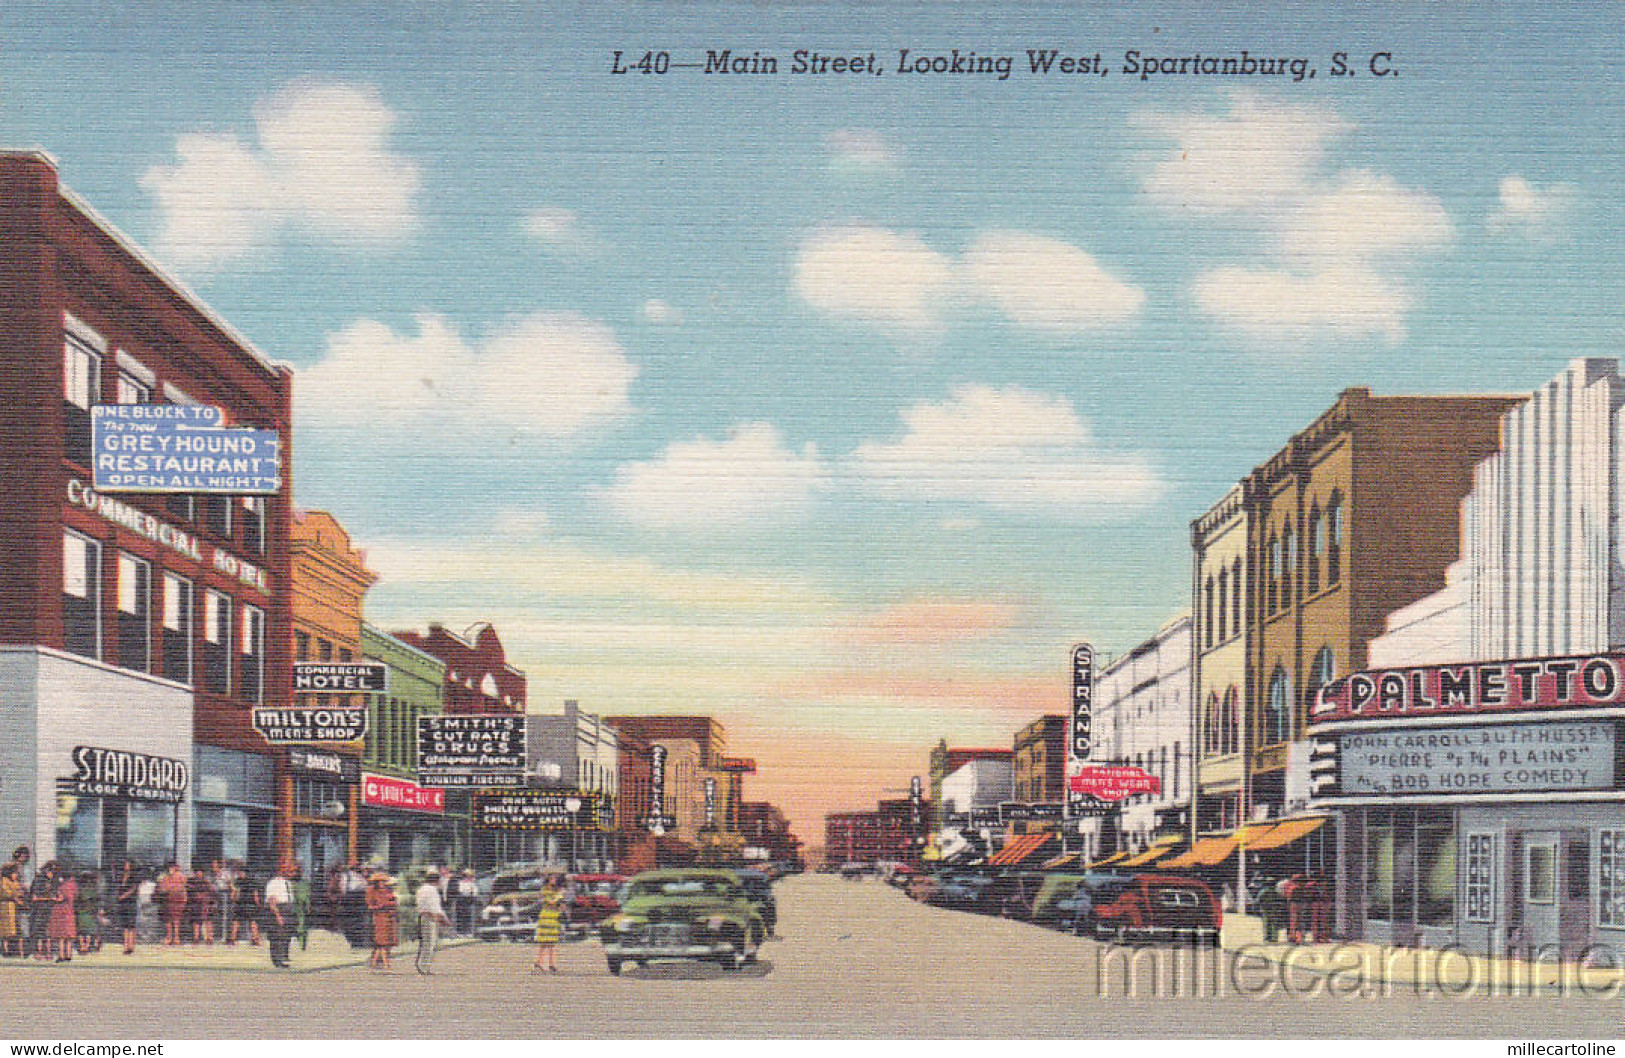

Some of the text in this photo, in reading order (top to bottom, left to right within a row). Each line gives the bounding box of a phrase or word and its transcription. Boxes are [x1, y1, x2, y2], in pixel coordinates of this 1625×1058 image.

[94, 405, 215, 420] ONE BLOCK TO
[103, 434, 256, 455] GREYHOUND
[99, 453, 262, 473] RESTAURANT
[108, 474, 263, 488] OPEN ALL NIGHT
[67, 478, 272, 596] COMMERCIAL HOTEL
[297, 666, 373, 675] COMMERCIAL
[297, 675, 372, 689] HOTEL
[1349, 656, 1619, 715] PALMETTO
[1075, 650, 1091, 749] STRAND
[258, 709, 360, 727] MILTON'S
[430, 718, 514, 730] SMITH'S
[269, 727, 355, 739] MEN'S SHOP
[433, 731, 511, 742] CUT RATE
[1343, 725, 1612, 749] JOHN CARROLL RUTH HUSSEY
[435, 742, 511, 754] DRUGS
[76, 747, 187, 791] STANDARD
[1391, 773, 1430, 789] BOB
[1440, 772, 1492, 787] HOPE
[1503, 769, 1589, 784] COMEDY
[128, 786, 181, 801] COMPANY
